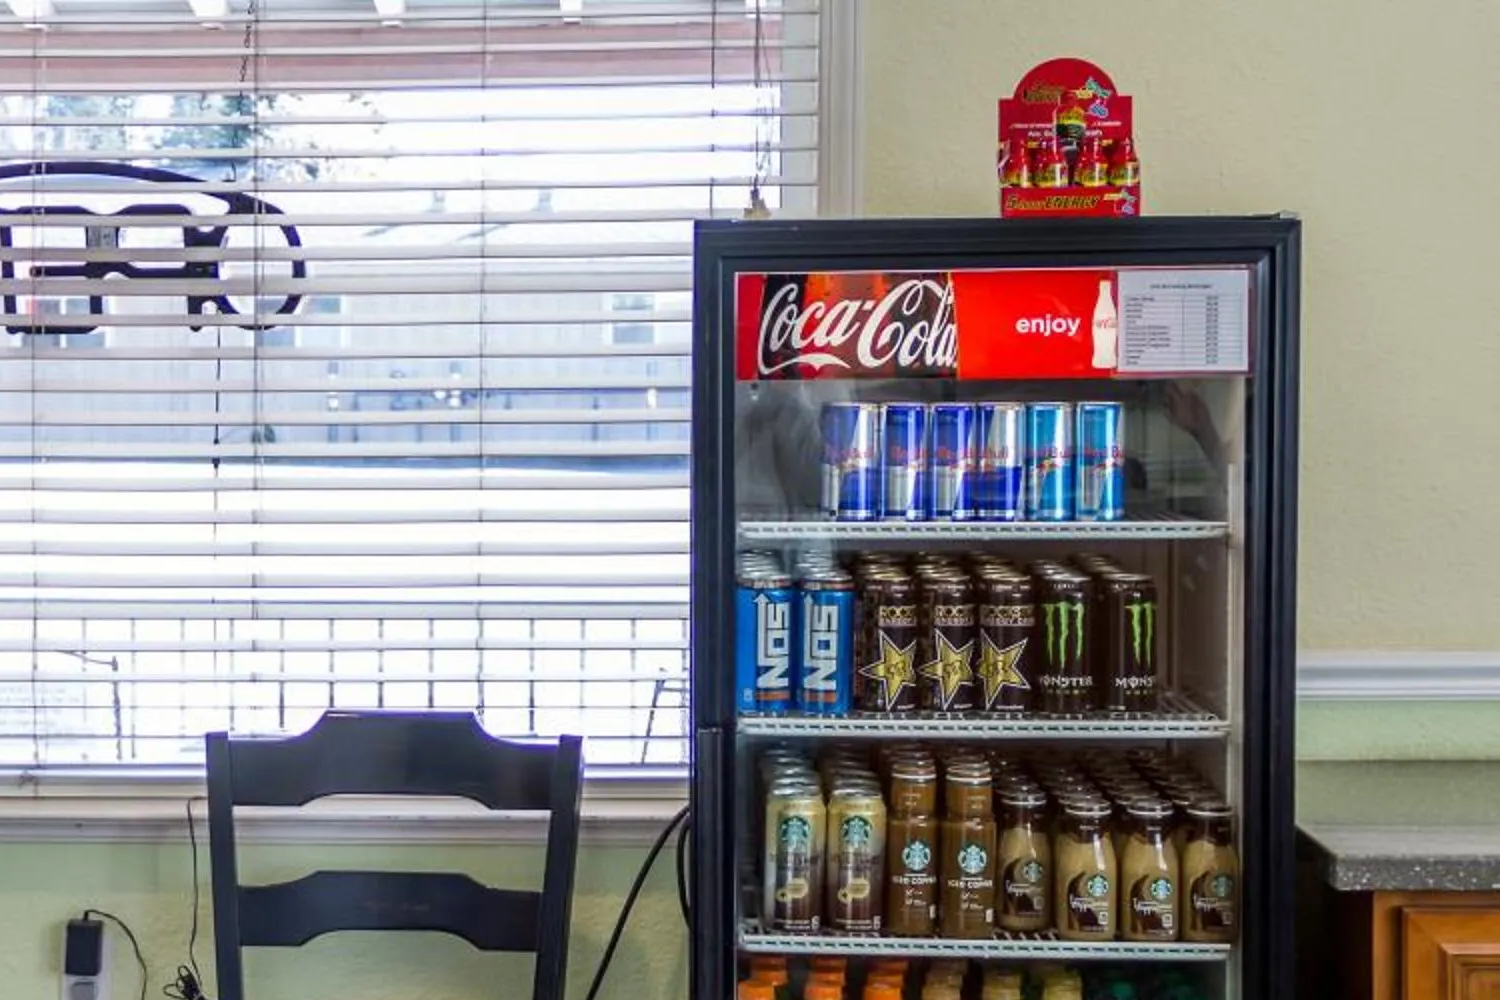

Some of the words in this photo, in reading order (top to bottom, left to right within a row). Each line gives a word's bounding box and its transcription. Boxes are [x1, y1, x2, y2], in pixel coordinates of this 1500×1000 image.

[757, 279, 959, 375] Coca-Cola
[1015, 313, 1081, 336] enjoy
[756, 594, 790, 689] NOS
[803, 595, 839, 690] NOS
